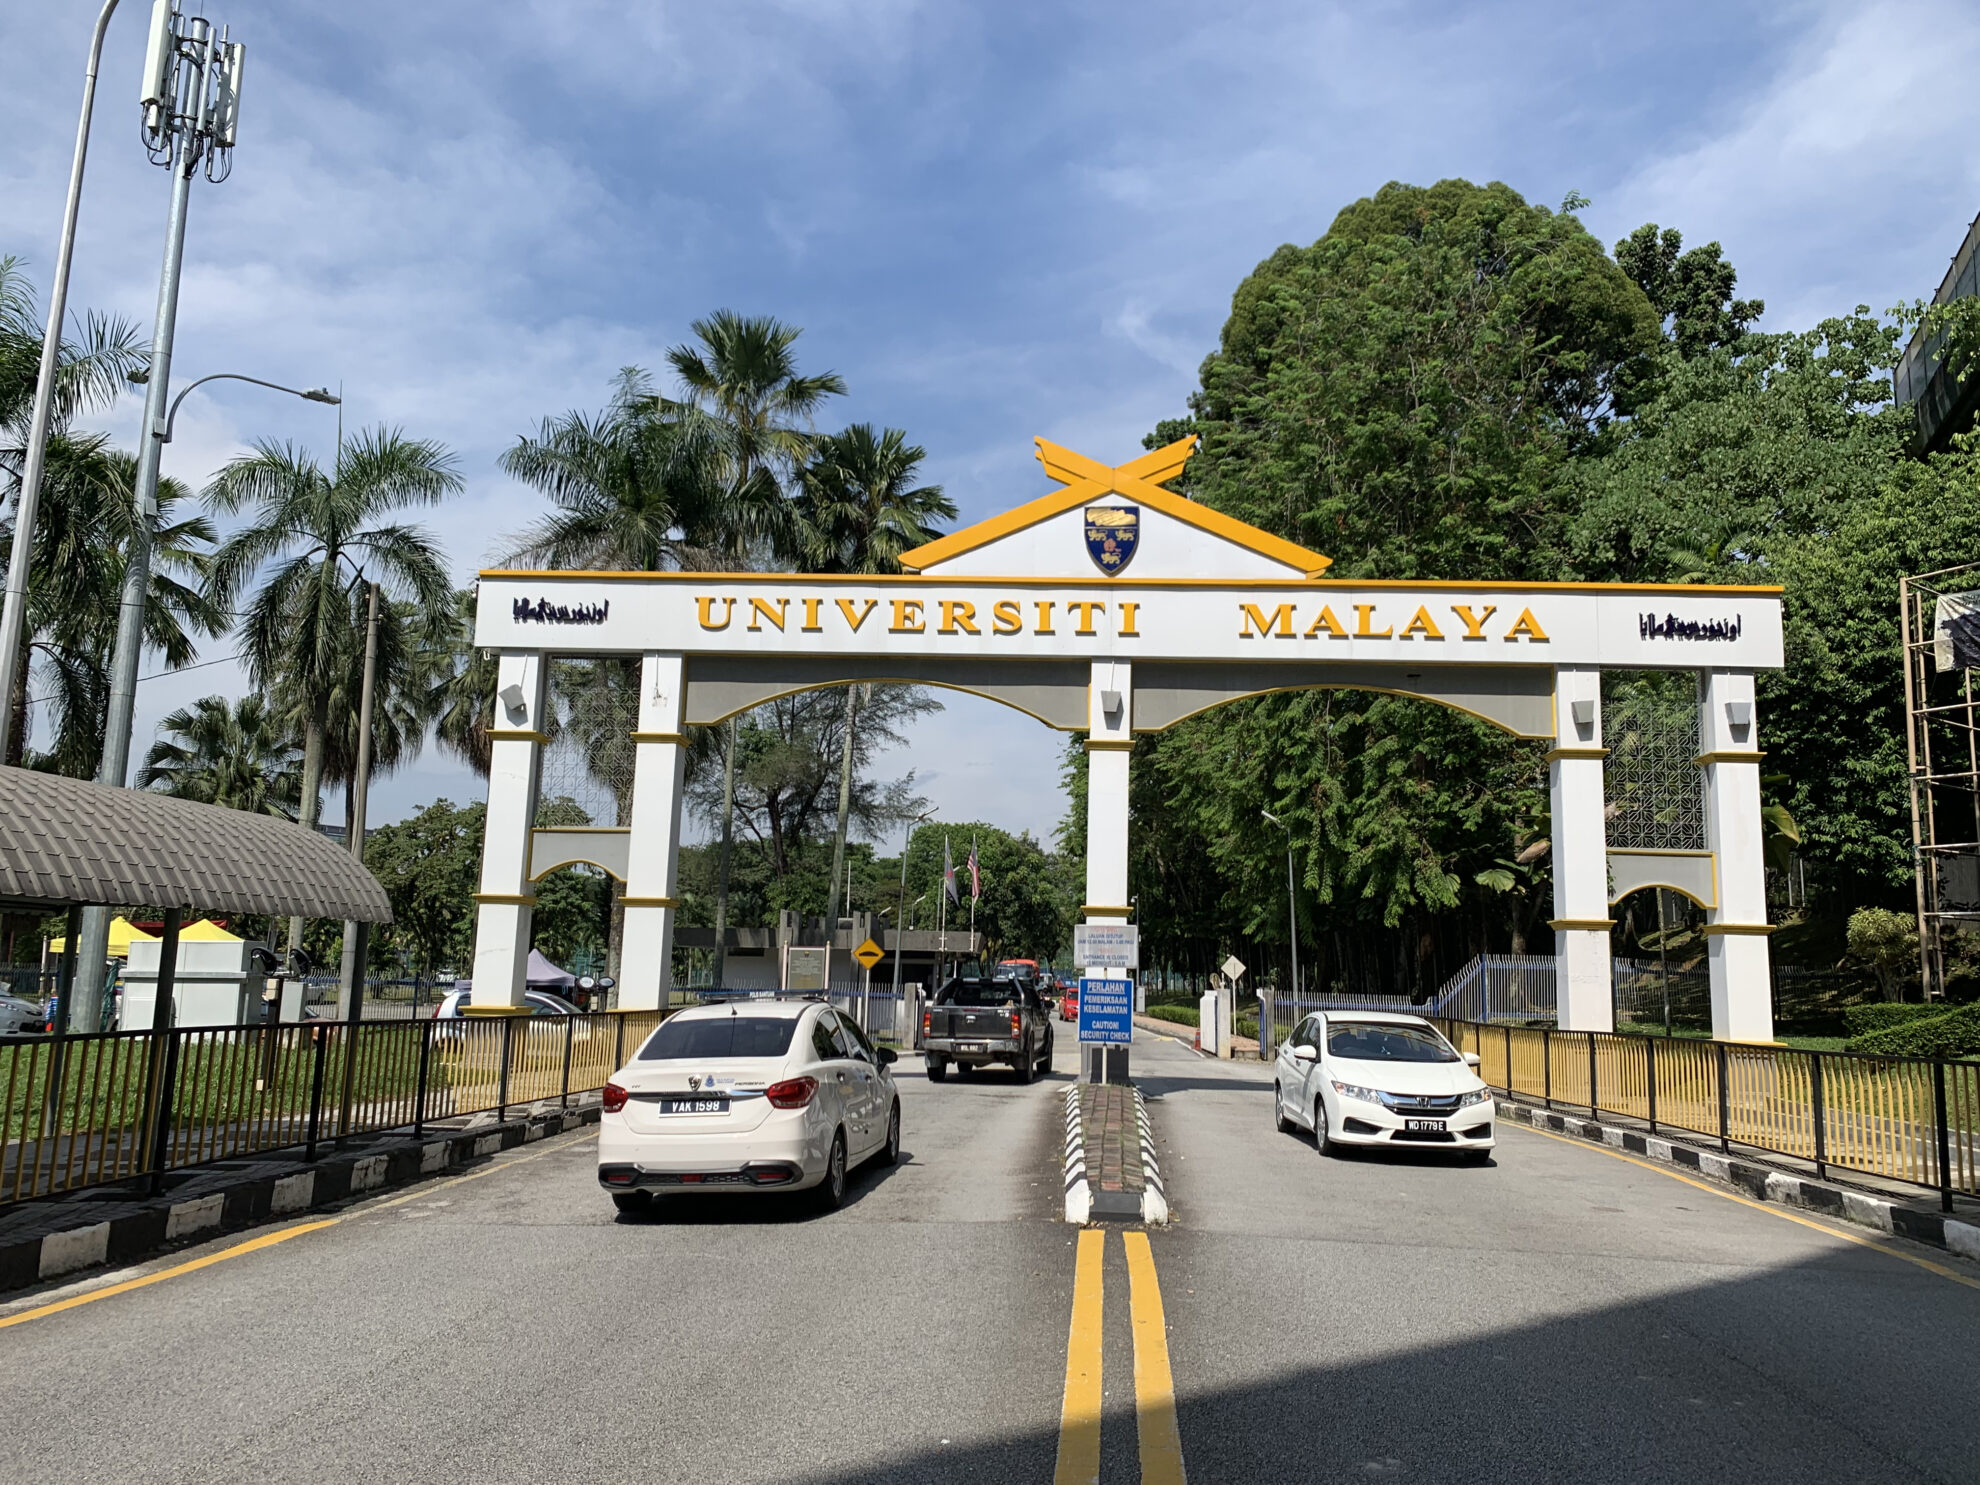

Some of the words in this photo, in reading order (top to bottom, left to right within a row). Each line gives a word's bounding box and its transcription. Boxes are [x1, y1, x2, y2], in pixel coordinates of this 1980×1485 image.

[694, 596, 1141, 637] UNIVERSITI
[1239, 603, 1550, 642] MALAYA
[1087, 981, 1126, 994] PERLAHAN
[1084, 994, 1128, 1005] PEMERIKSAAN
[1083, 1004, 1128, 1015] KESELAMATAN
[1080, 1030, 1109, 1040] SECURITY
[1109, 1031, 1130, 1041] CHECK
[671, 1101, 692, 1113] VAK
[695, 1100, 720, 1112] 1598
[1420, 1121, 1438, 1131] 1779
